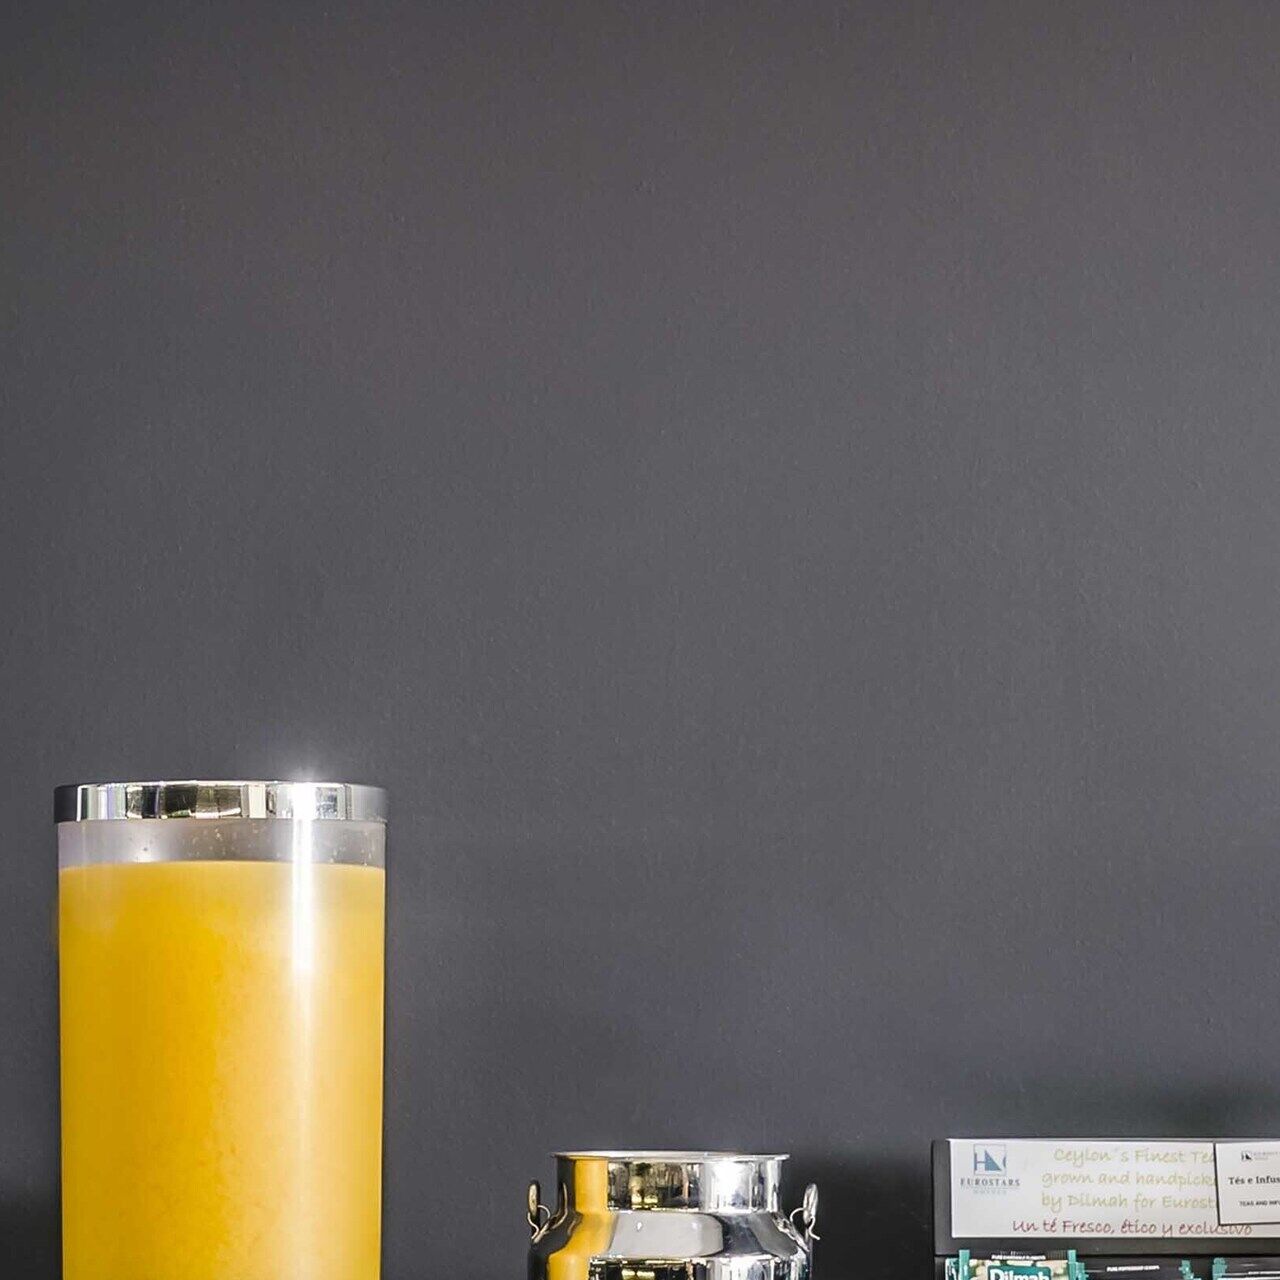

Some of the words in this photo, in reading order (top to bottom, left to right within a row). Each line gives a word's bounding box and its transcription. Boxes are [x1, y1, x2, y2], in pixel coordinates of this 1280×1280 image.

[1134, 1149, 1184, 1164] Finest
[960, 1177, 1021, 1187] EUROSTARS
[1041, 1173, 1094, 1189] grown
[1098, 1172, 1130, 1185] and
[1228, 1176, 1246, 1186] Tés
[1041, 1193, 1062, 1213] by
[1068, 1194, 1128, 1208] Dilmah
[1134, 1193, 1155, 1213] for
[1012, 1219, 1039, 1233] Un
[1043, 1218, 1058, 1233] té
[1062, 1219, 1116, 1235] Fresco,
[1120, 1218, 1157, 1234] ético
[1162, 1221, 1174, 1238] y
[1178, 1220, 1253, 1236] exclusivo
